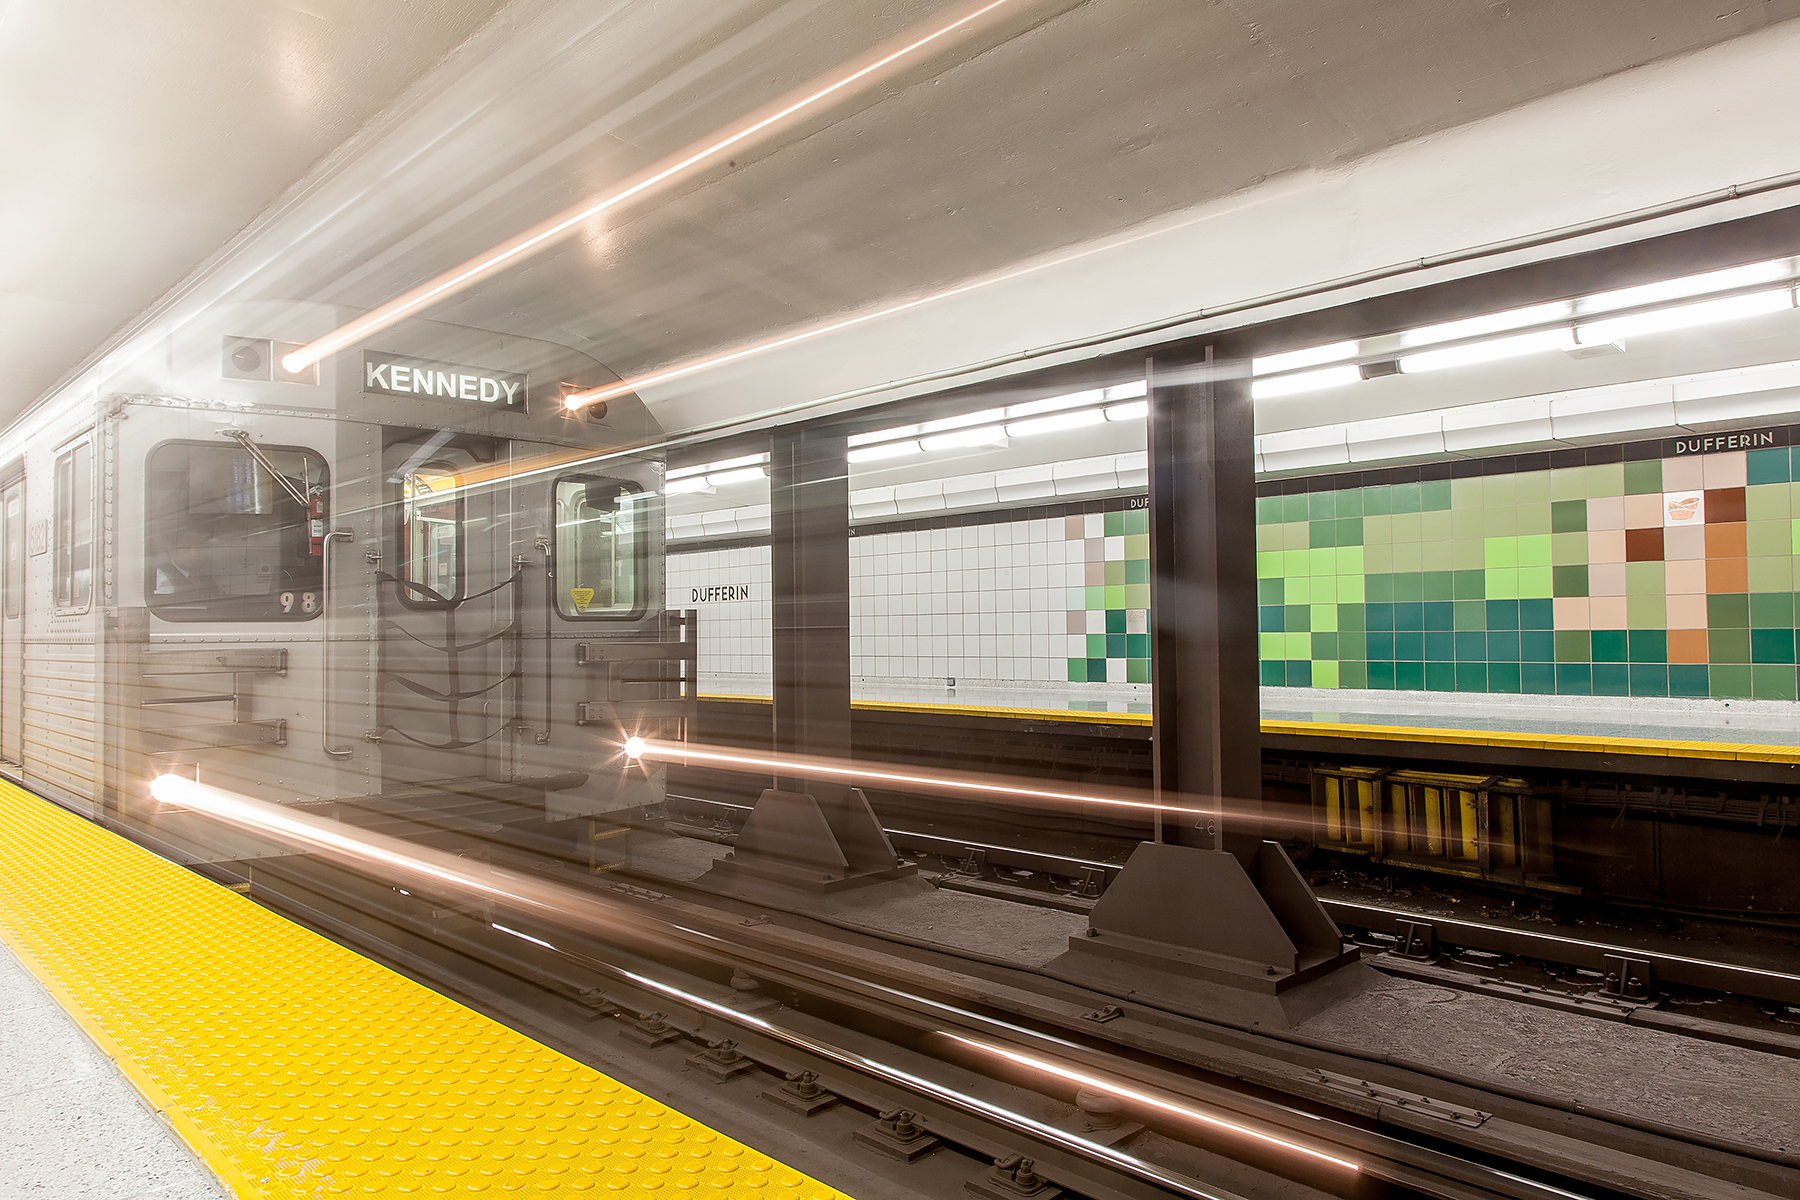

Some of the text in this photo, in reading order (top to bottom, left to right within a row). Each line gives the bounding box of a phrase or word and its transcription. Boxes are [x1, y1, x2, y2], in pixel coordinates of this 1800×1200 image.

[366, 361, 521, 405] KENNEDY
[1676, 431, 1774, 455] DUFFERIN
[691, 584, 749, 603] DUFFERIN
[1194, 817, 1216, 836] 46
